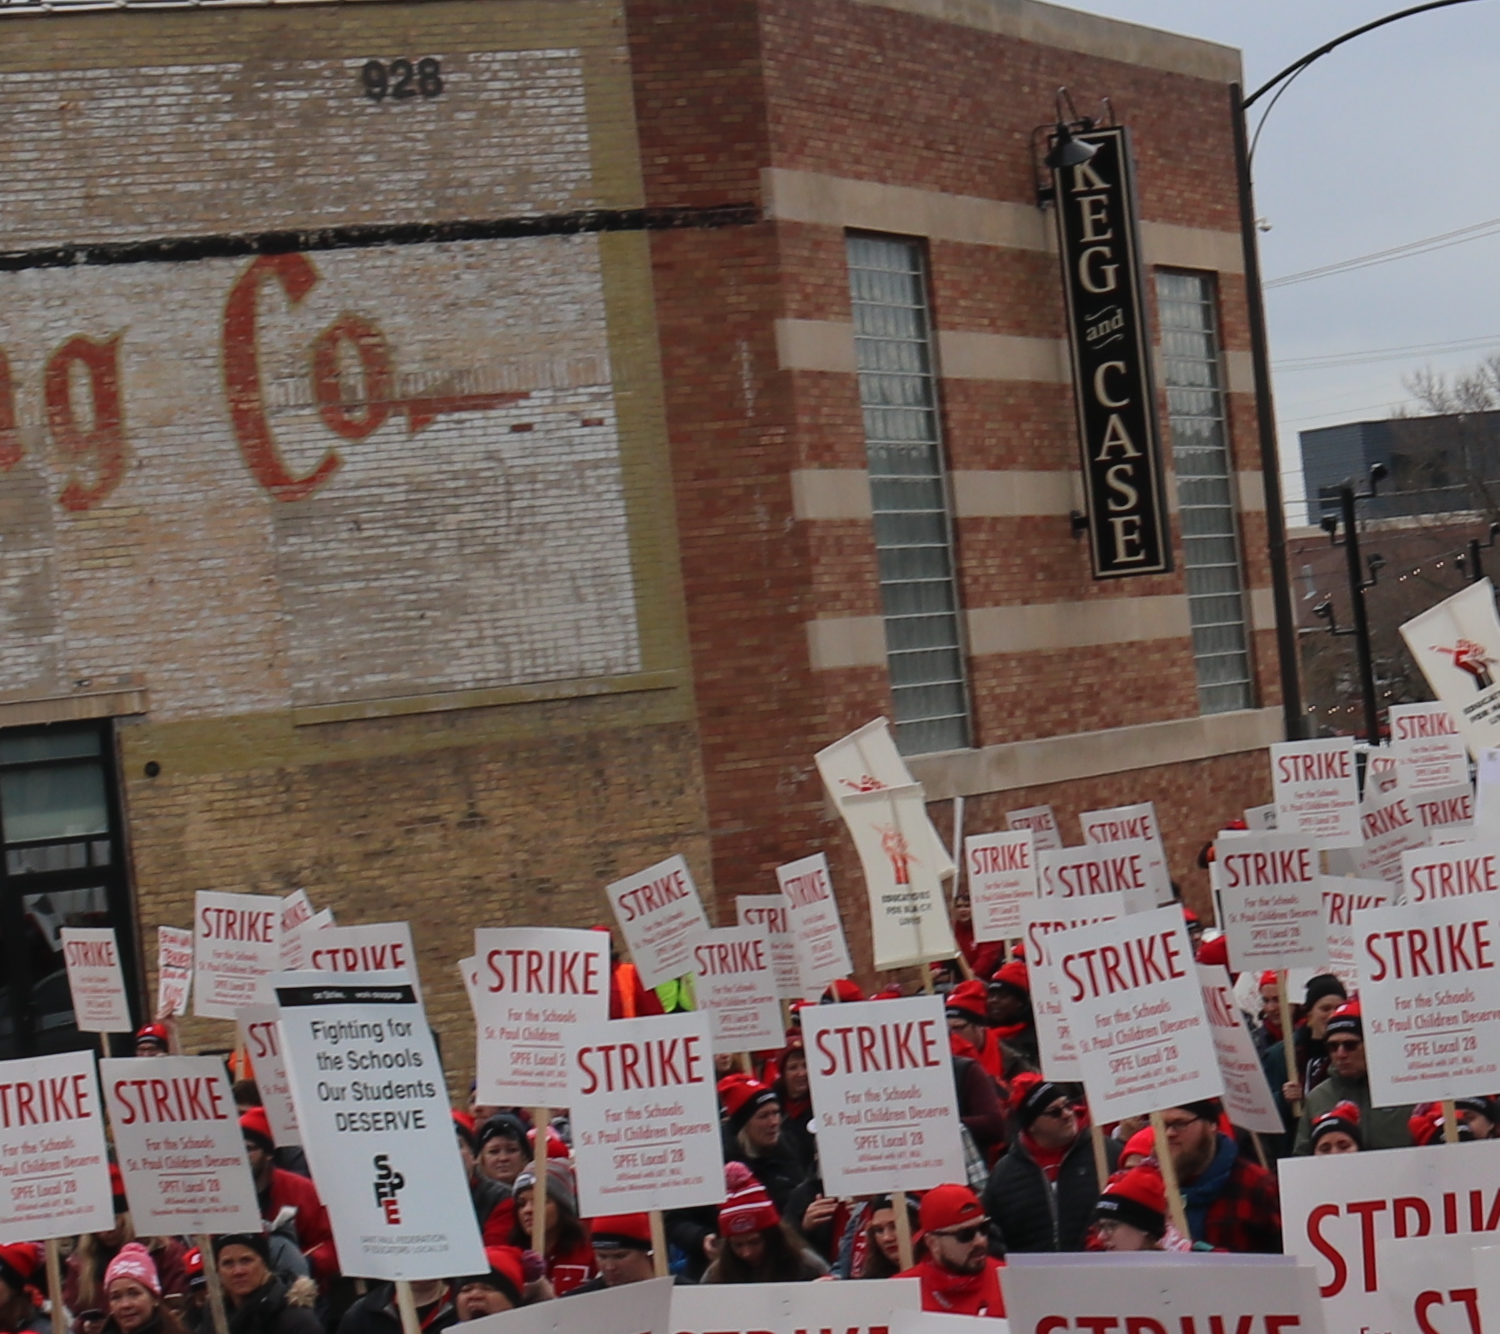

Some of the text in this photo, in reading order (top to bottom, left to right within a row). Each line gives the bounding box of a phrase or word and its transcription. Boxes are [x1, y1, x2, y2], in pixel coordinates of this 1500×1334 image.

[362, 57, 444, 100] 928
[1071, 140, 1145, 564] KEG and CASE
[1278, 750, 1351, 783] STRIKE
[1224, 849, 1312, 888] STRIKE
[1411, 856, 1498, 902] STRIKE
[487, 950, 598, 995] STRIKE
[1063, 931, 1185, 1002] STRIKE
[1366, 921, 1494, 981] STRIKE
[310, 1018, 411, 1045] Fighting for
[816, 1020, 940, 1076] STRIKE
[316, 1049, 423, 1070] the Schools
[577, 1036, 703, 1094] STRIKE
[317, 1080, 436, 1101] Our Students
[335, 1110, 426, 1132] DESERVE
